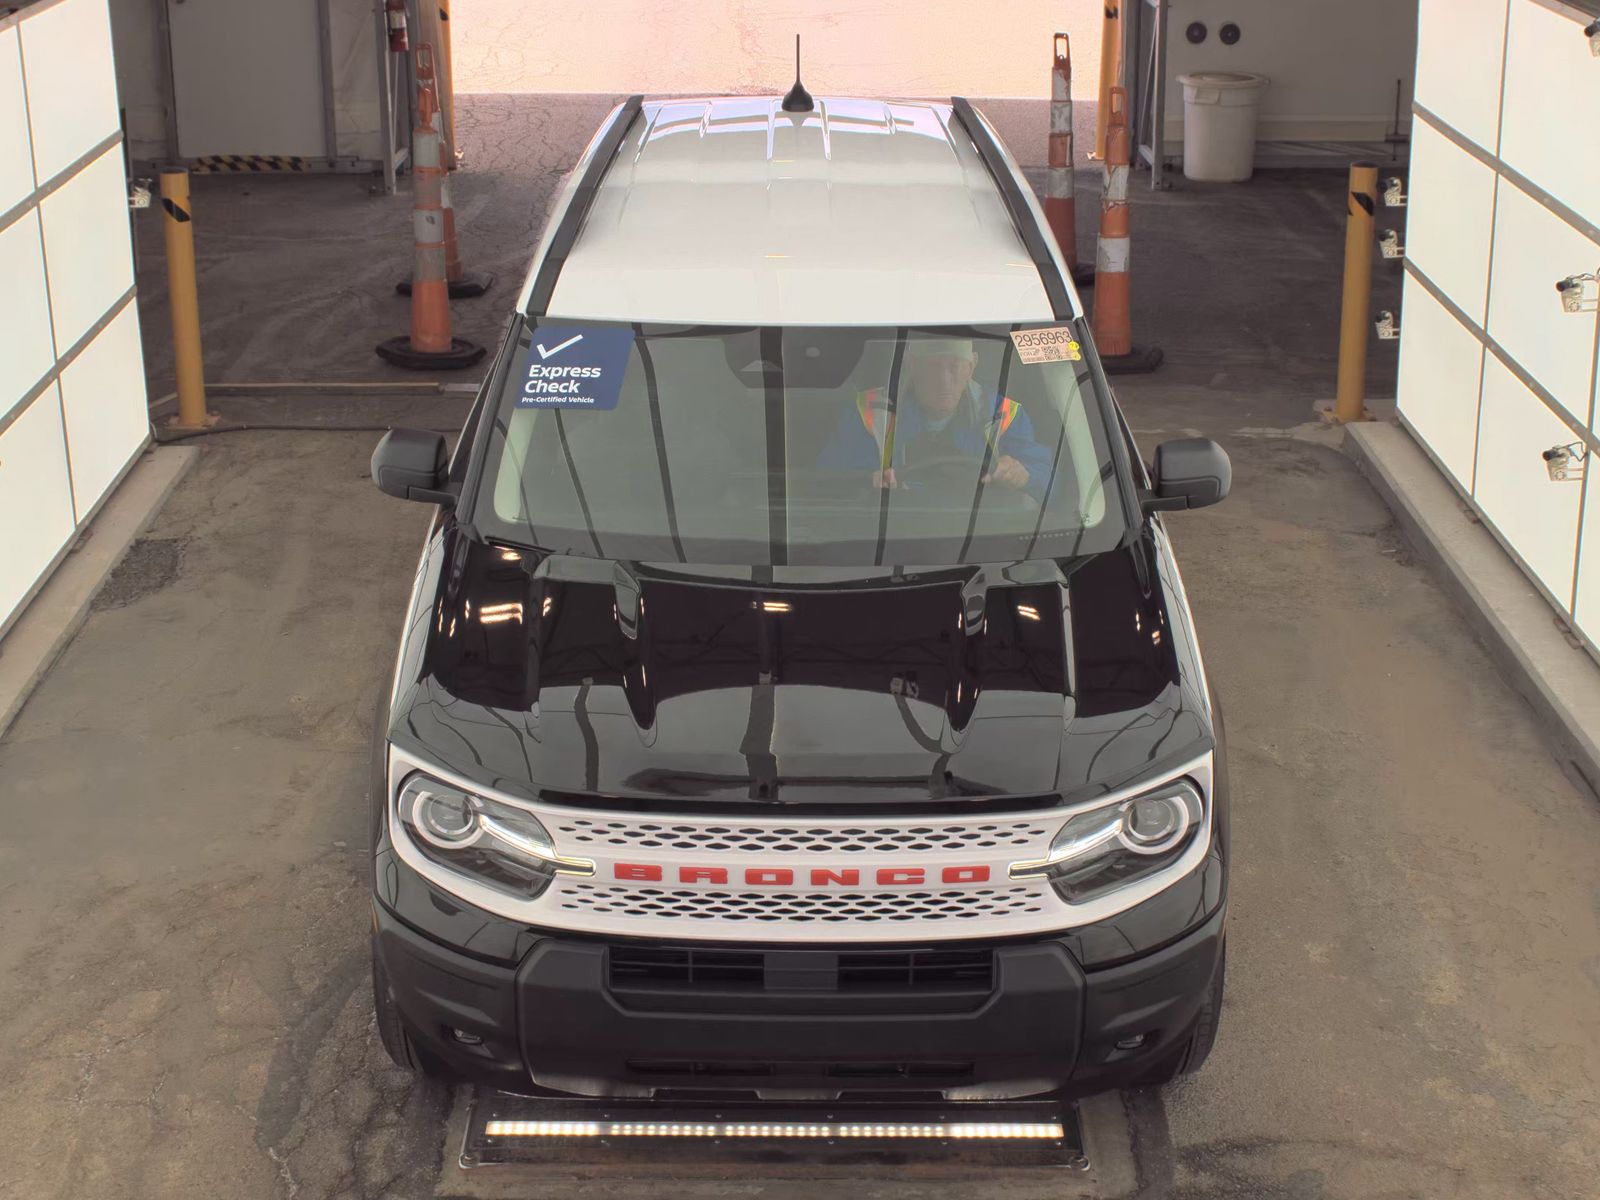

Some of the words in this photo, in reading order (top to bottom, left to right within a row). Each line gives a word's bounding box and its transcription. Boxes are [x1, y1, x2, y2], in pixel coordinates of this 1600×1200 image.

[1015, 331, 1072, 347] 2956963
[529, 365, 601, 379] Express
[525, 380, 581, 393] Check
[568, 396, 595, 404] Vehicle
[614, 863, 991, 886] BRONCO
